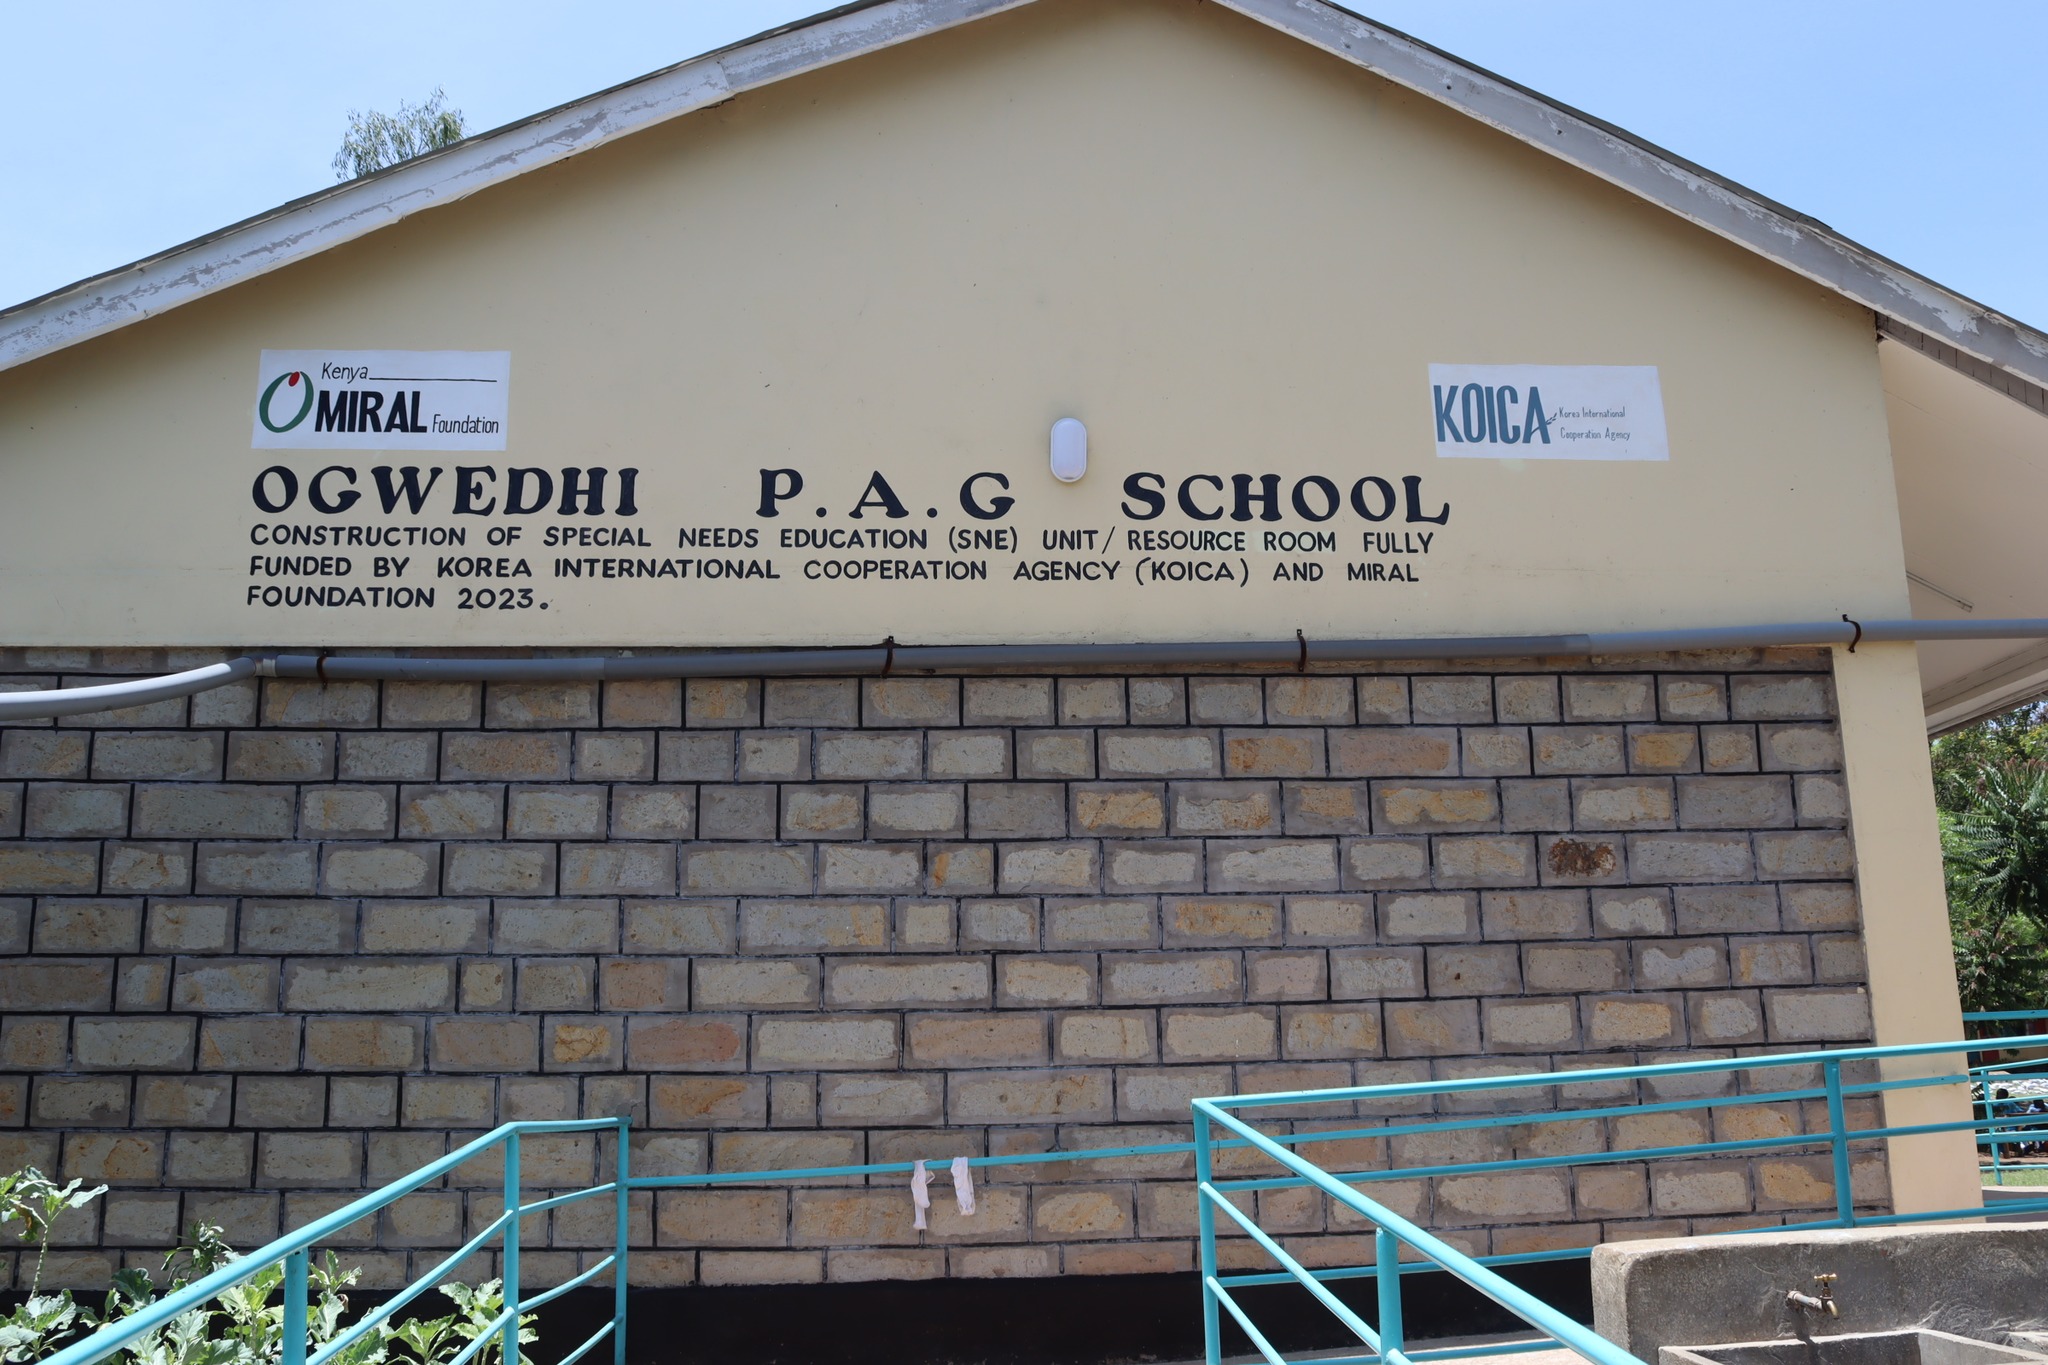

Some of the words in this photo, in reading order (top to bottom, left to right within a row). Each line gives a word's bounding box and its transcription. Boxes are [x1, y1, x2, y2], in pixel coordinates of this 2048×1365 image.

[321, 361, 369, 385] Kenya
[432, 414, 499, 434] Foundation
[1433, 383, 1551, 444] KOICA
[1559, 407, 1580, 418] Korea
[1582, 406, 1626, 418] International
[1560, 427, 1602, 441] Cooperation
[1604, 427, 1631, 441] Agency
[251, 465, 640, 518] OGWEDHI
[1120, 471, 1450, 526] SCHOOL
[250, 523, 466, 547] CONSTRUCTION
[486, 526, 523, 547] OF
[542, 525, 652, 548] SPECIAL
[678, 527, 759, 549] NEEDS
[780, 528, 928, 550] EDUCATION
[948, 525, 1018, 554] (SNE)
[1127, 529, 1246, 552] RESOURCE
[1263, 531, 1336, 553] ROOM
[1363, 531, 1434, 554] FULLY
[249, 555, 352, 578] FUNDED
[373, 556, 411, 578] BY
[436, 557, 533, 579] KOREA
[554, 557, 780, 580] INTERNATIONAL
[803, 558, 987, 581] COOPERATION
[1012, 560, 1121, 582] AGENCY
[1135, 556, 1249, 588] (KOICA)
[1272, 561, 1324, 582] AND
[1347, 562, 1420, 583] MIRAL
[246, 585, 435, 609] FOUNDATION
[457, 587, 549, 611] 2023.
